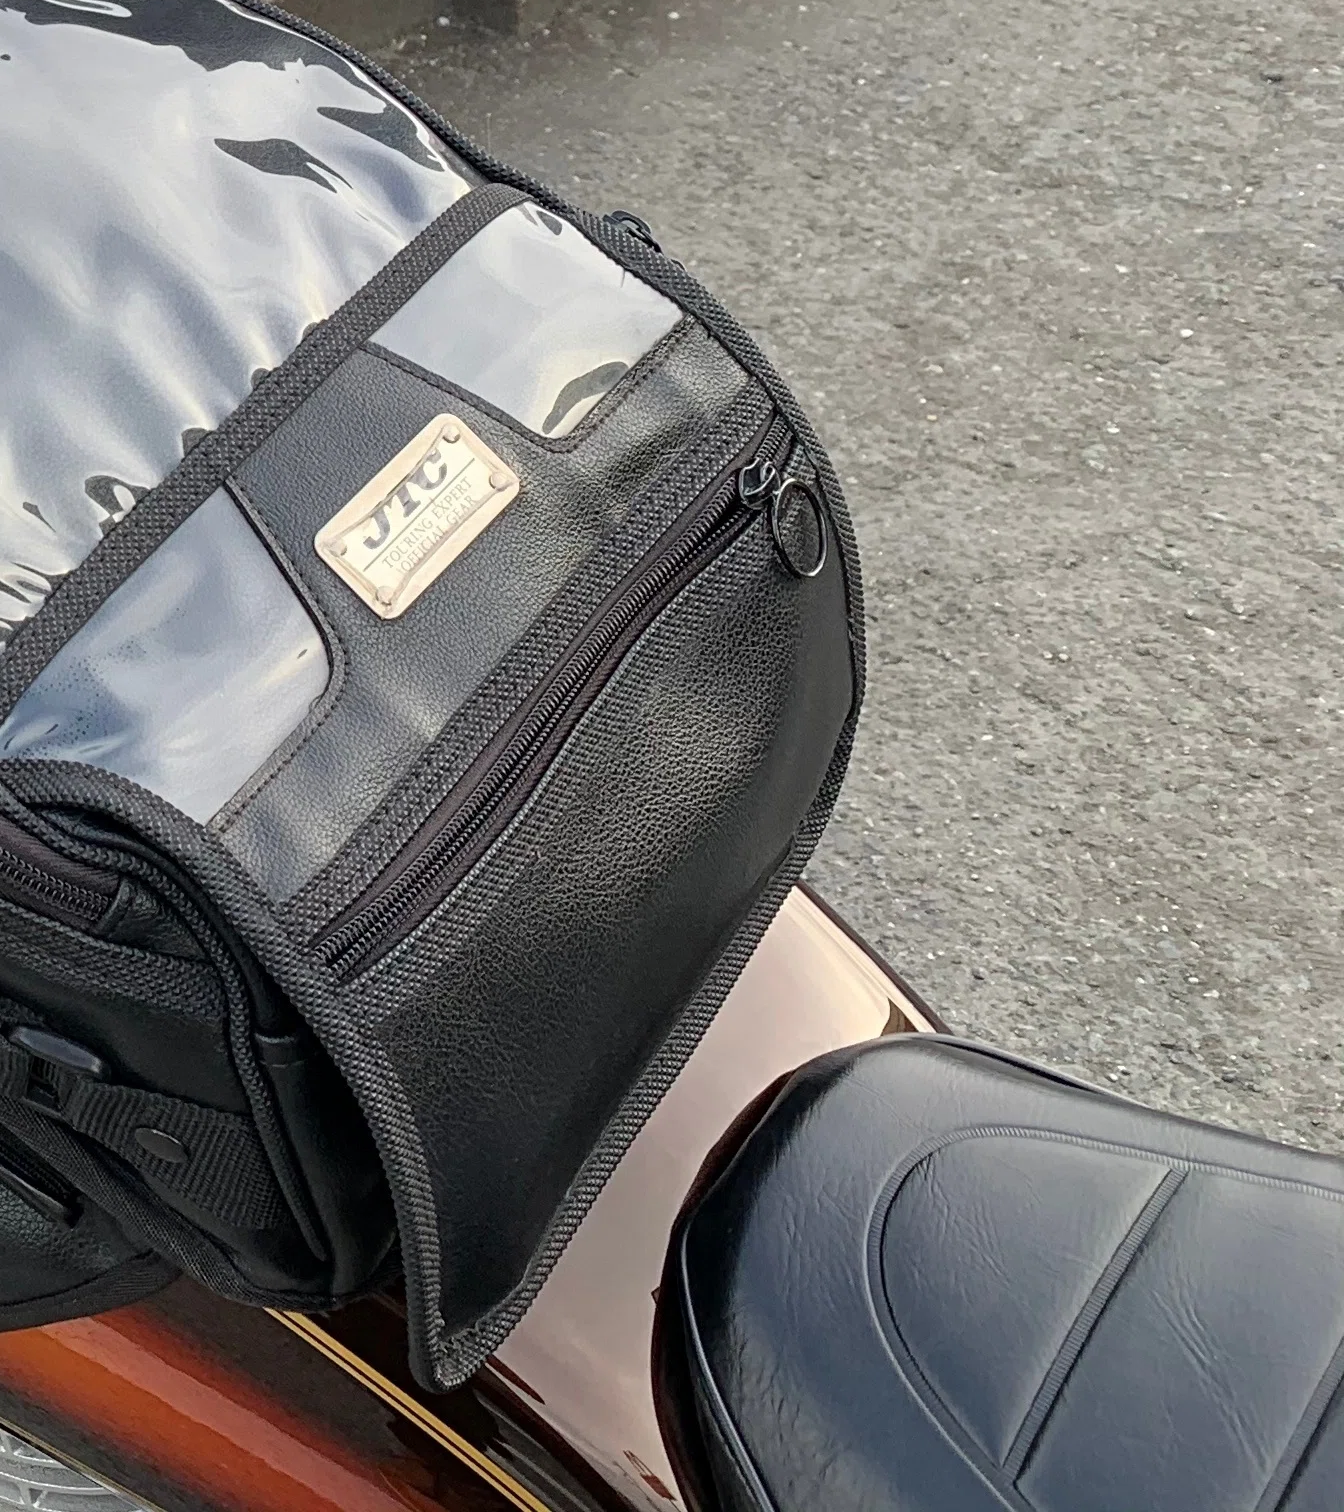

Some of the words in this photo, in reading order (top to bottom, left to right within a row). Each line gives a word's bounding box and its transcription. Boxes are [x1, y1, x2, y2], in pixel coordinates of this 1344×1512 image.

[382, 518, 433, 569] TOURING
[432, 476, 473, 519] EXPERT
[400, 525, 449, 573] OFFICIAL
[445, 495, 477, 526] GEAR
